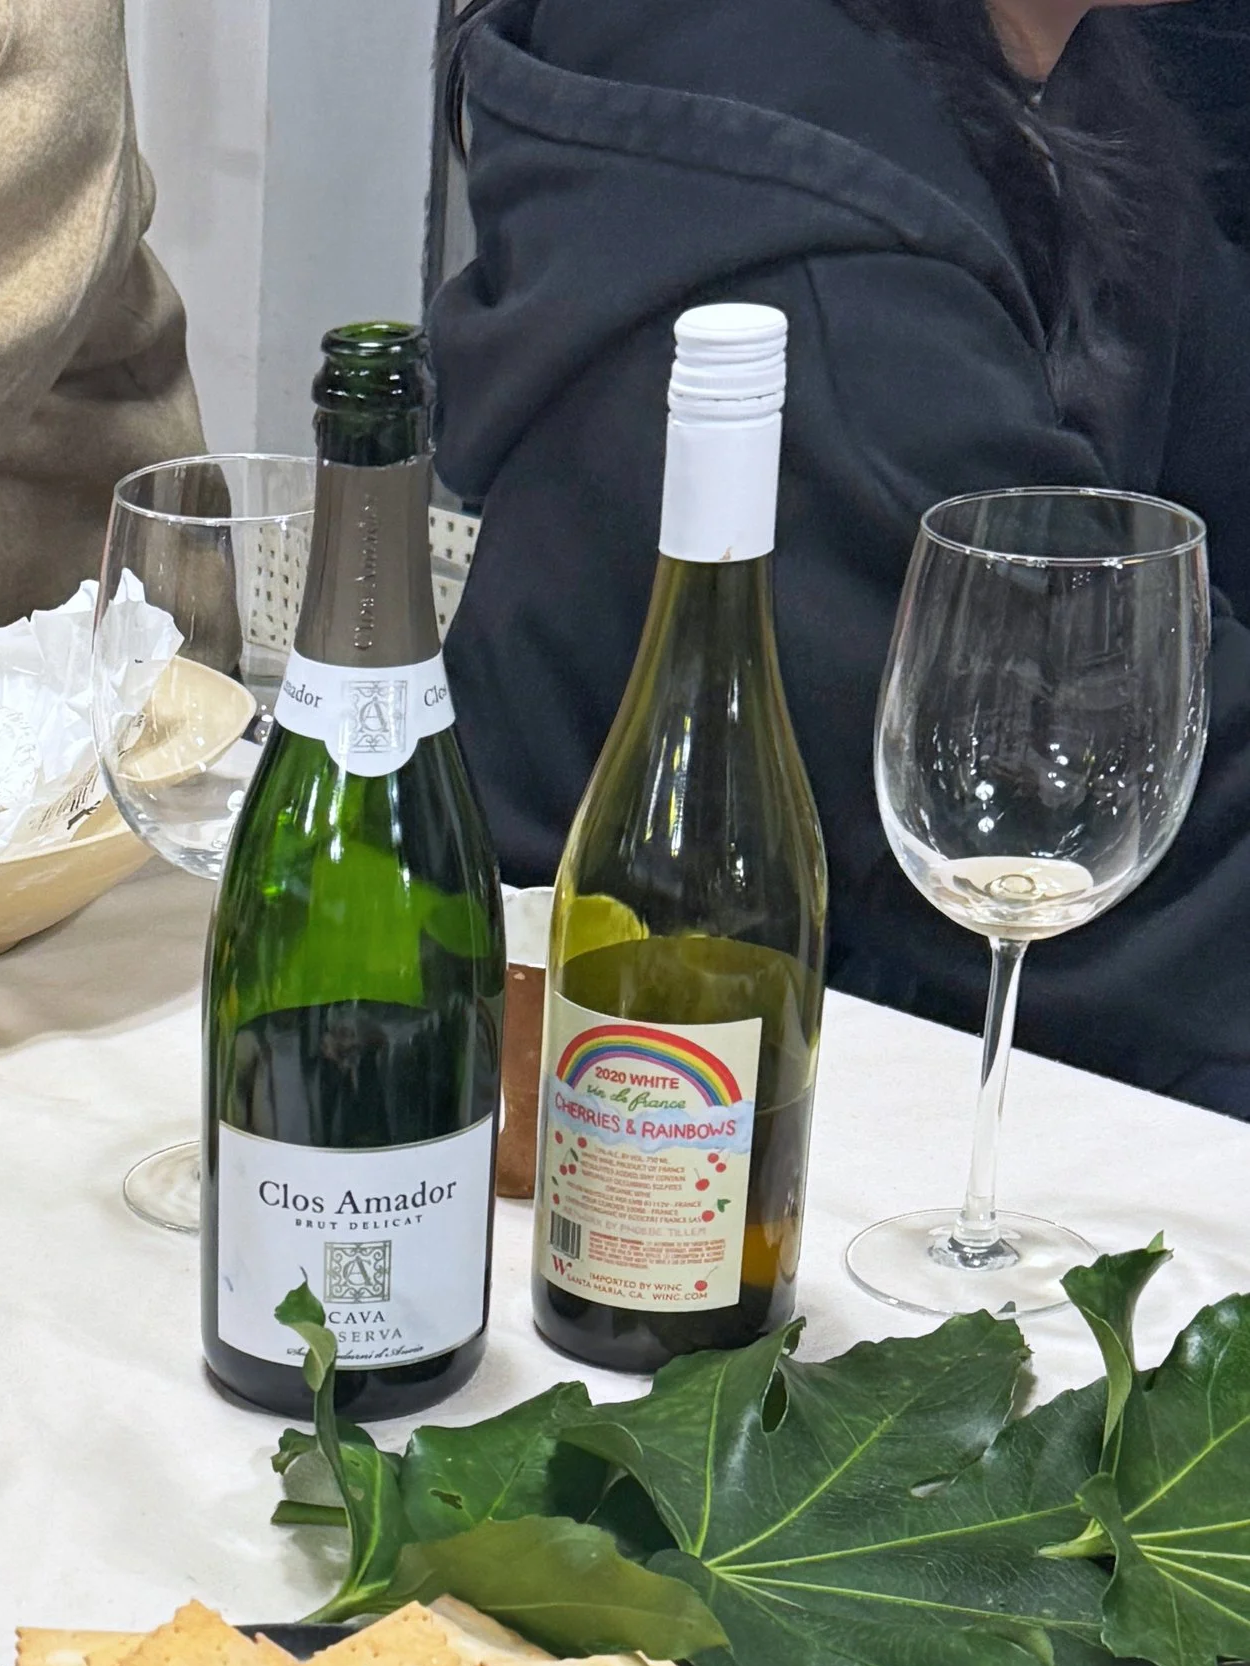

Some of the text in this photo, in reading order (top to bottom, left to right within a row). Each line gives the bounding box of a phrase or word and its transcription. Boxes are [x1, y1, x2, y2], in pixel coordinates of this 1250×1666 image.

[594, 1066, 680, 1090] 2020 WHITE
[554, 1091, 737, 1140] CHERRIES & RAINBOWS
[258, 1180, 458, 1215] Clos Amador
[295, 1214, 424, 1231] BRUT DELICAT
[589, 1272, 683, 1292] IMPORTED BY WINC
[327, 1310, 386, 1325] CAVA
[337, 1327, 403, 1344] SERVA
